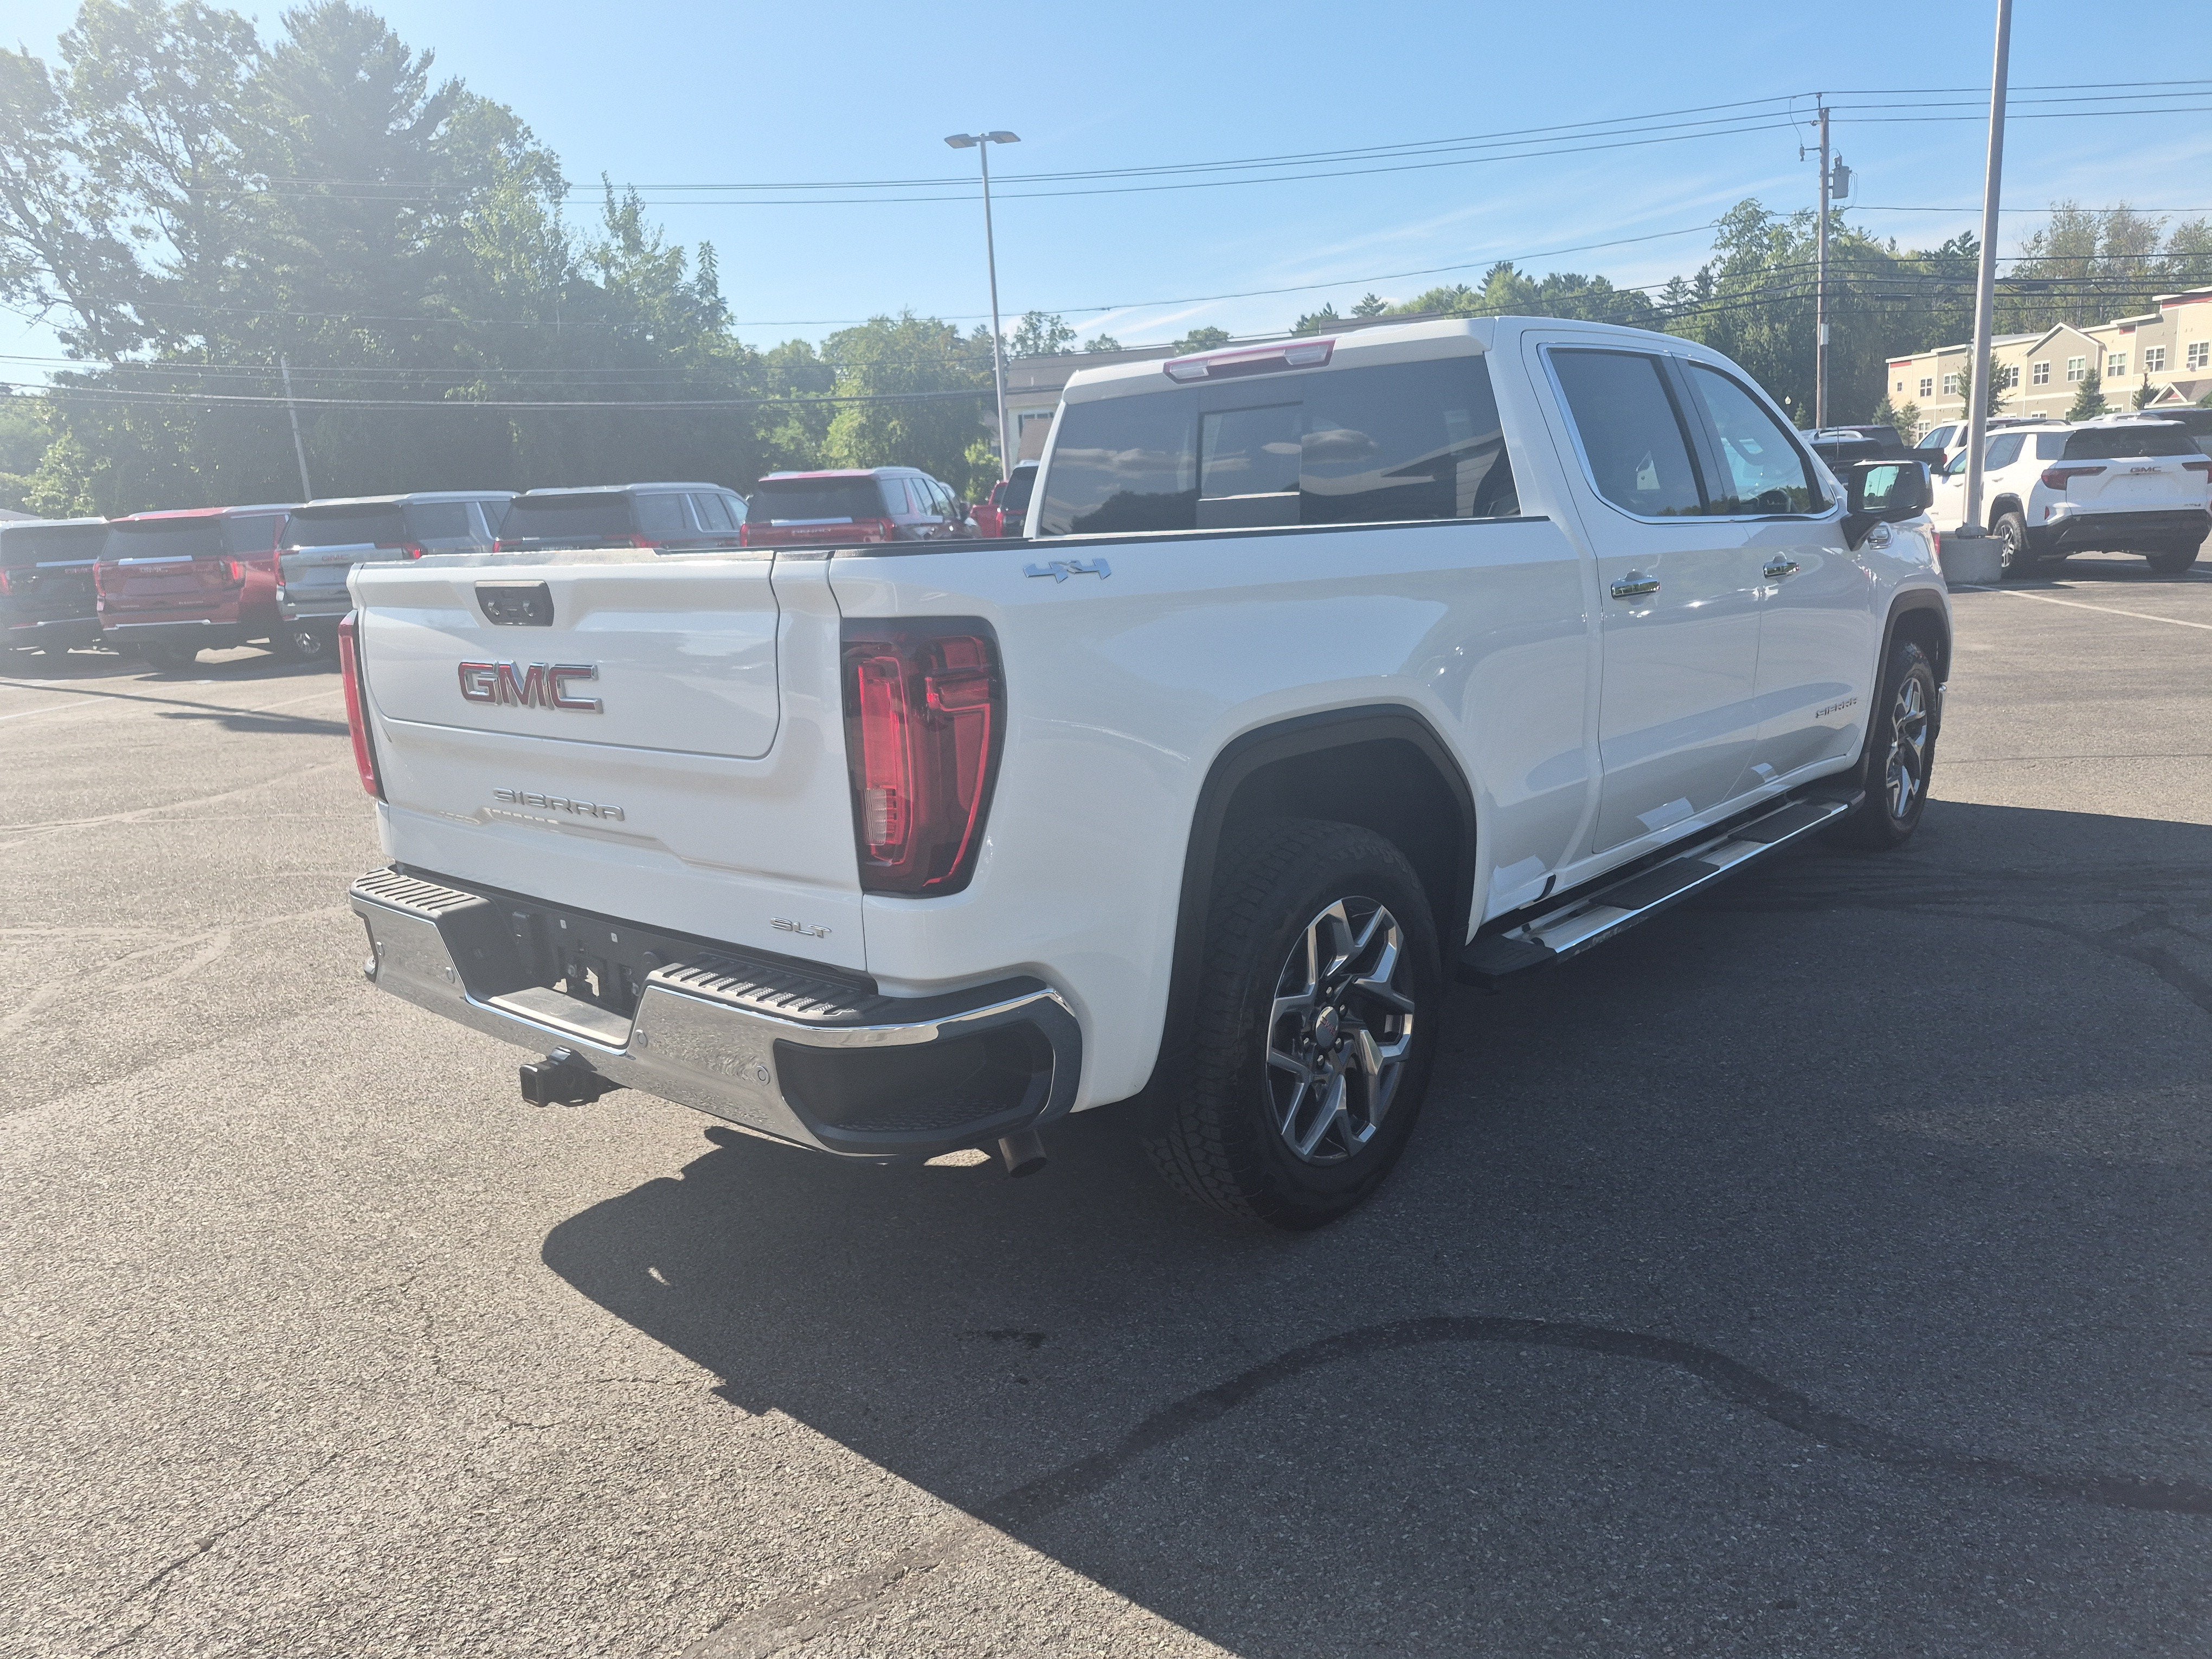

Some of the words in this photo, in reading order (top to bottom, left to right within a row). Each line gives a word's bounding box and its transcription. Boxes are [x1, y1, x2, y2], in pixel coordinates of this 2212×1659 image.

[458, 658, 604, 714] GMC
[492, 787, 626, 822] SIERRA
[770, 917, 832, 938] SLT
